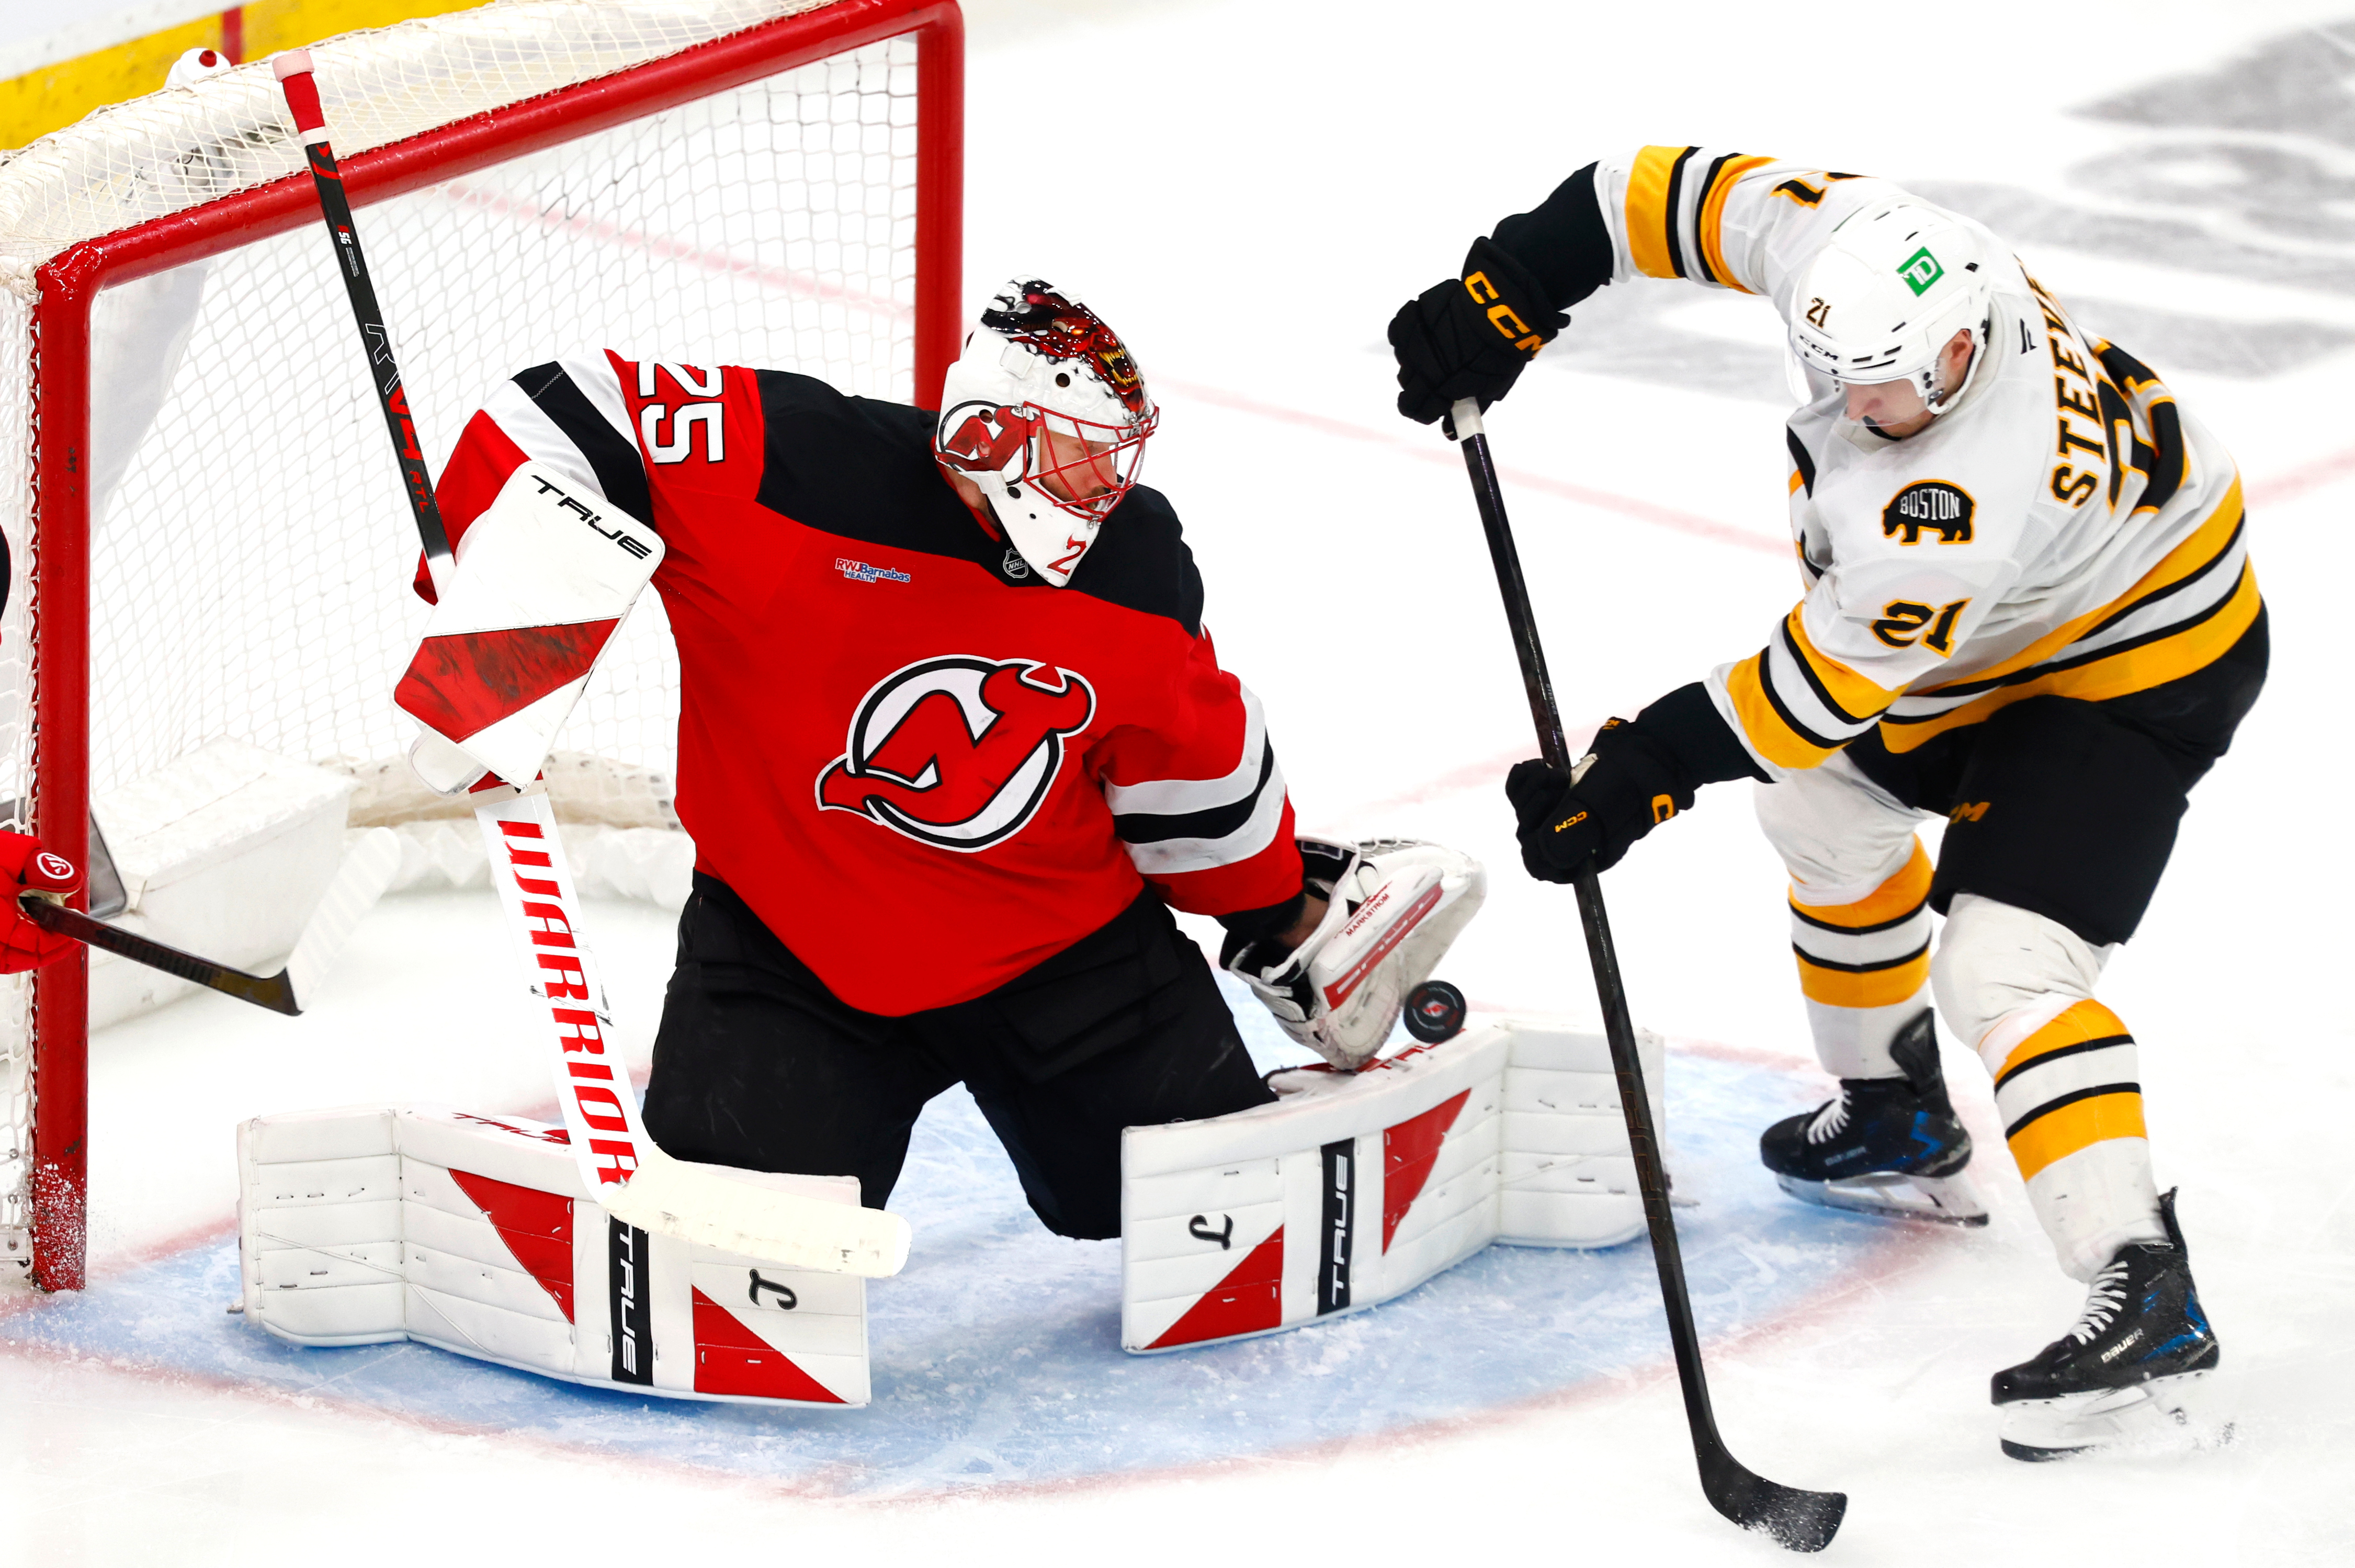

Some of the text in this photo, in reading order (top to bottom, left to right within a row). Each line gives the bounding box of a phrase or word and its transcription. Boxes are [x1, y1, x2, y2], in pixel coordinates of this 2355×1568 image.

[1903, 255, 1939, 286] TD
[1464, 271, 1547, 358] CCM
[1806, 297, 1832, 329] 21
[1799, 334, 1839, 361] CCM
[637, 361, 724, 464] 25
[409, 471, 429, 513] RTL
[1899, 488, 1961, 520] BOSTON
[530, 474, 653, 560] TRUE
[845, 570, 876, 582] HEALTH
[1007, 560, 1025, 571] NHL
[1869, 597, 1973, 659] 21
[1555, 811, 1588, 833] CCM
[1345, 893, 1390, 937] MARKSTROM
[497, 820, 639, 1186] WARRIOR
[1331, 1154, 1349, 1306] TRUE
[619, 1223, 638, 1376] TRUE
